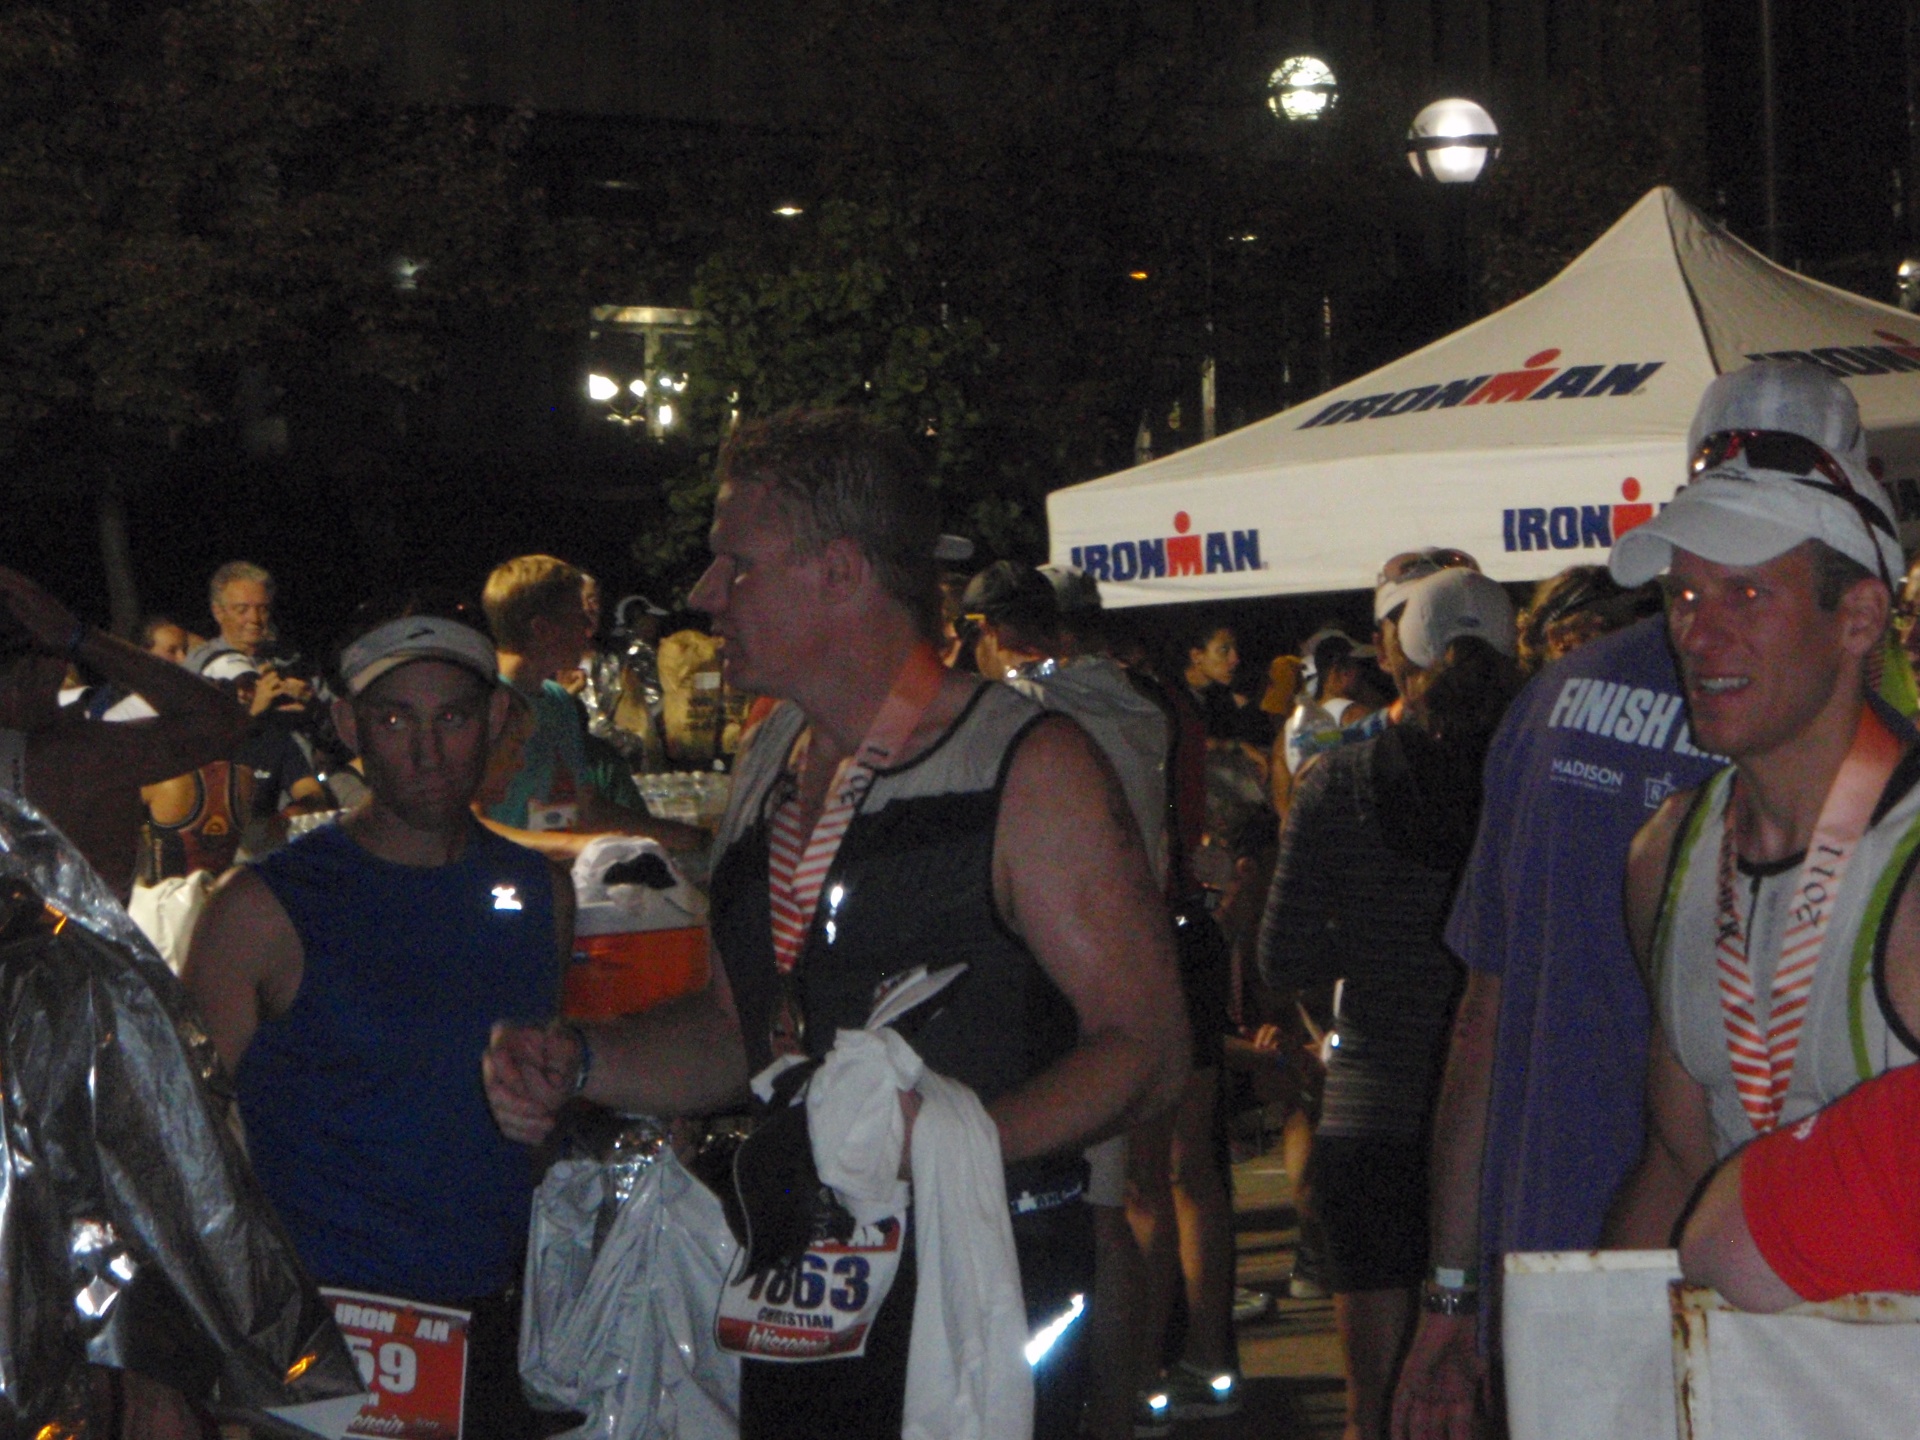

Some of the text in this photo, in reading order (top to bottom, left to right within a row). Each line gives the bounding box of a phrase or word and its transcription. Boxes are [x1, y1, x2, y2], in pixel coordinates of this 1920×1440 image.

[1294, 348, 1666, 430] IRONMAN
[1071, 511, 1261, 582] IRONMAN
[1503, 477, 1675, 552] IRONM
[1548, 678, 1684, 750] FINISH
[1551, 759, 1624, 787] MADISON
[1796, 845, 1843, 928] 2011
[757, 1306, 834, 1330] CHRISTIAN
